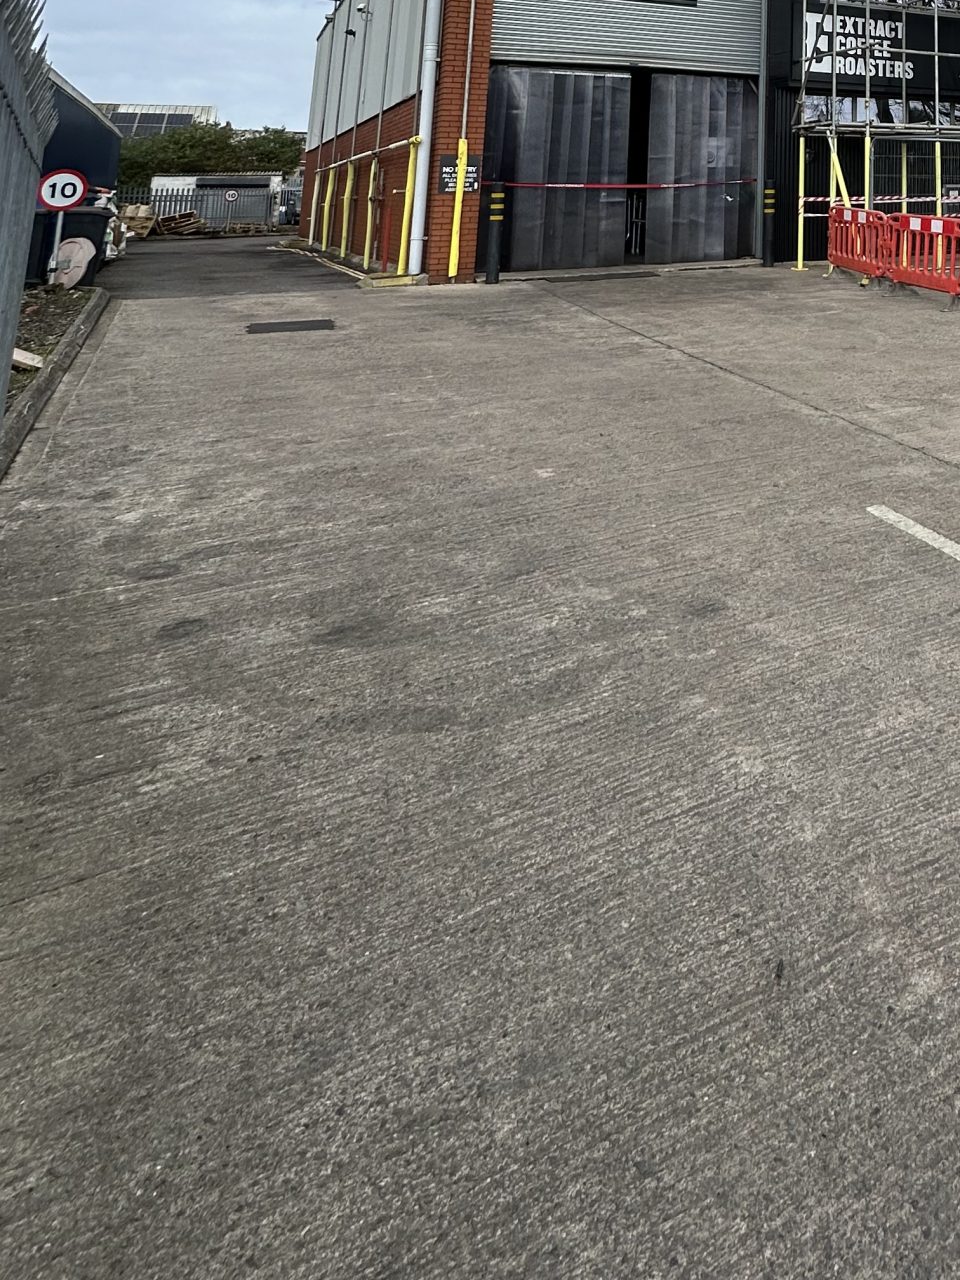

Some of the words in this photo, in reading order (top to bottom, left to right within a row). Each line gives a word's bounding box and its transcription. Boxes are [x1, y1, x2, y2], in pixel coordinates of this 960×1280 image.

[836, 15, 904, 39] EXTRACT
[835, 56, 914, 79] ROASTERS
[49, 182, 78, 199] 10
